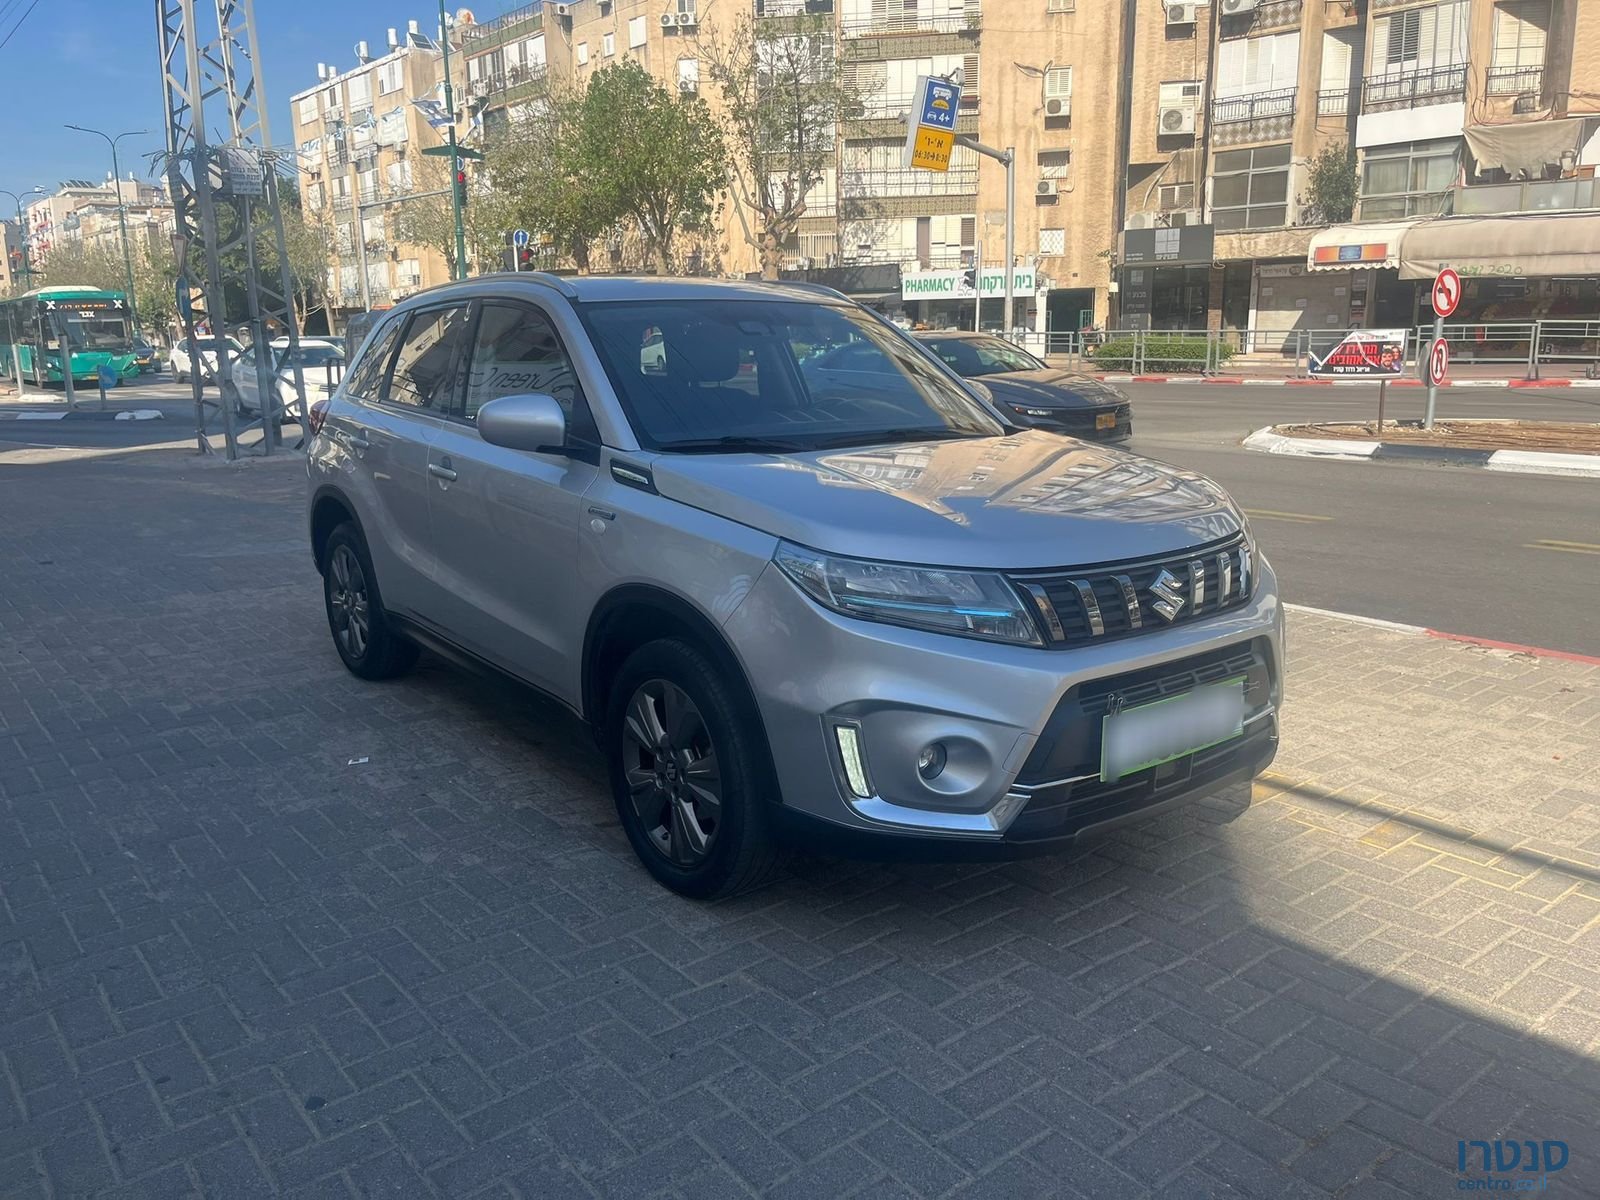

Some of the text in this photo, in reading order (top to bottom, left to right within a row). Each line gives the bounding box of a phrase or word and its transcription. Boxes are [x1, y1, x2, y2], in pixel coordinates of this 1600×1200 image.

[938, 112, 950, 122] 4+
[1487, 263, 1523, 276] 2020
[905, 277, 955, 293] PHARMACY
[1014, 274, 1033, 289] בית
[1345, 344, 1378, 355] תחירו
